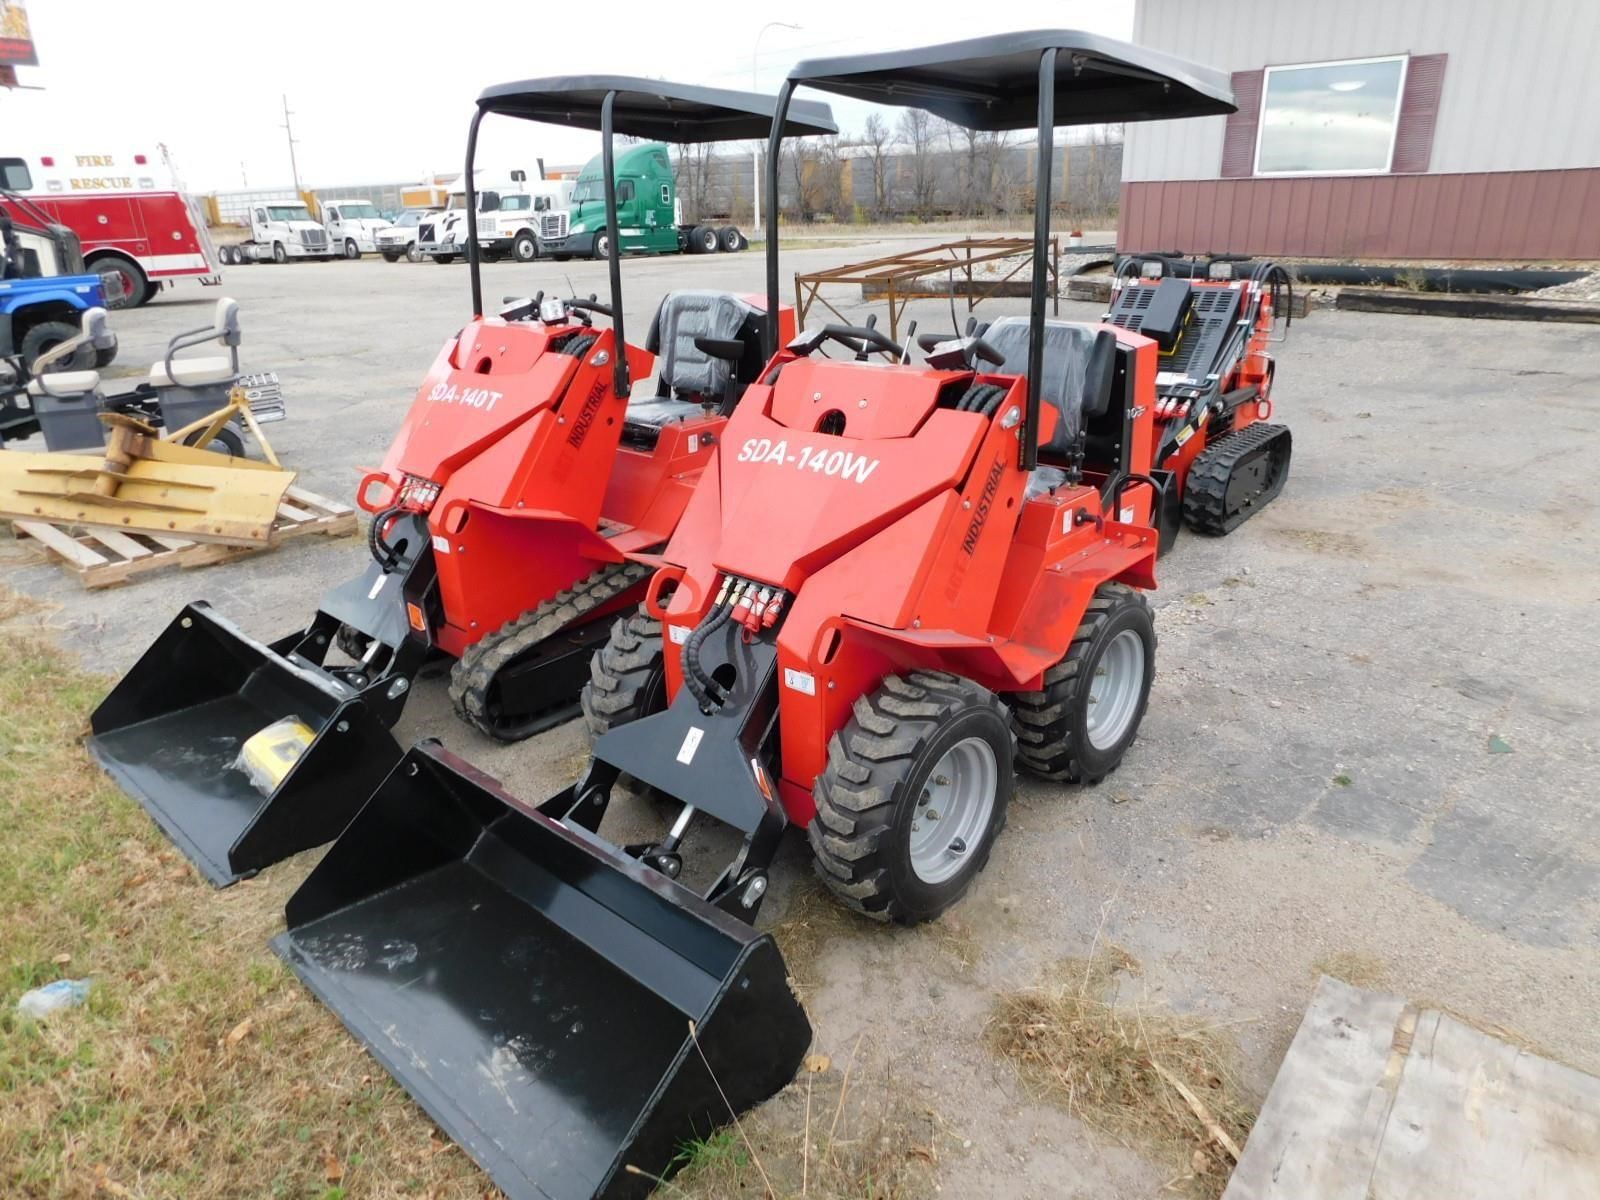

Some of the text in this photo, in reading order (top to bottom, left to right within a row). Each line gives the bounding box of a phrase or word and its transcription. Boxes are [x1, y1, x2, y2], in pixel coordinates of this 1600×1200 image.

[75, 155, 114, 167] FIRE
[70, 177, 132, 190] RESCUE
[427, 383, 503, 411] SDA-140T
[567, 379, 608, 450] INDUSTRIAL
[737, 438, 880, 484] SDA-140W
[962, 457, 1007, 556] INDUSTRIAL
